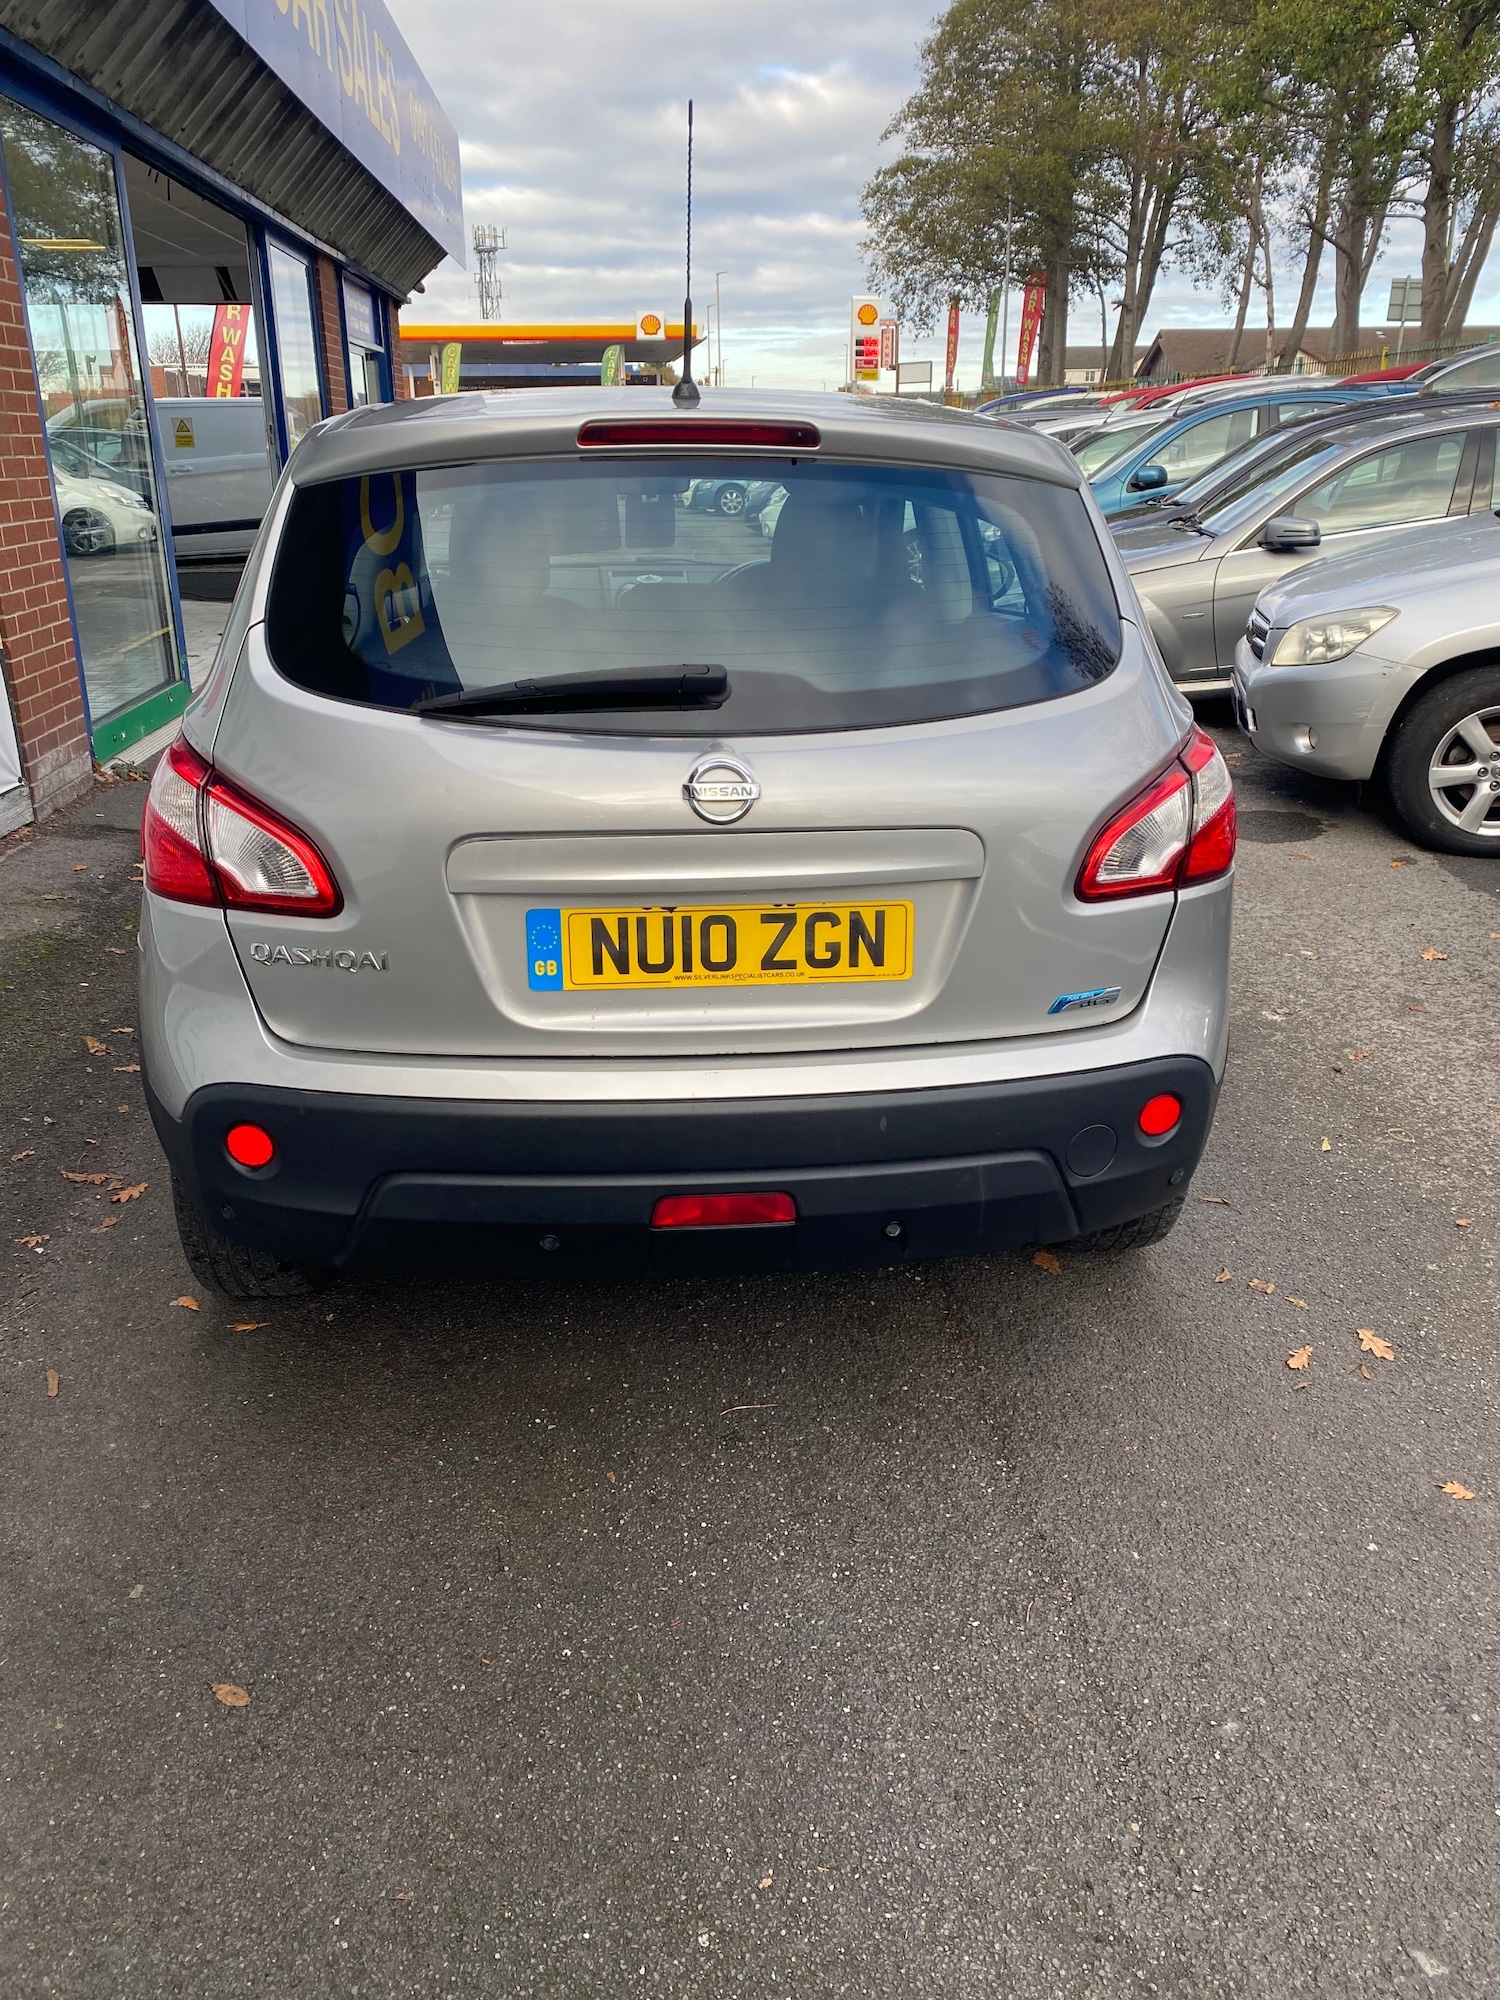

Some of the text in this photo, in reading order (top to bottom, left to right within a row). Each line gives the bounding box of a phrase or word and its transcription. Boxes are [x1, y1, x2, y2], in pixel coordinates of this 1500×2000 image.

[335, 0, 400, 157] SALES
[1020, 318, 1034, 364] WASH
[216, 326, 242, 398] WASH
[447, 347, 456, 378] CAR
[691, 786, 752, 797] NISSAN
[760, 909, 886, 971] ZGN
[250, 942, 389, 973] QASHQAI
[534, 959, 558, 976] GB
[674, 972, 806, 982] WWW.SILVERLINKSPECIALISTCARS.CO.UK
